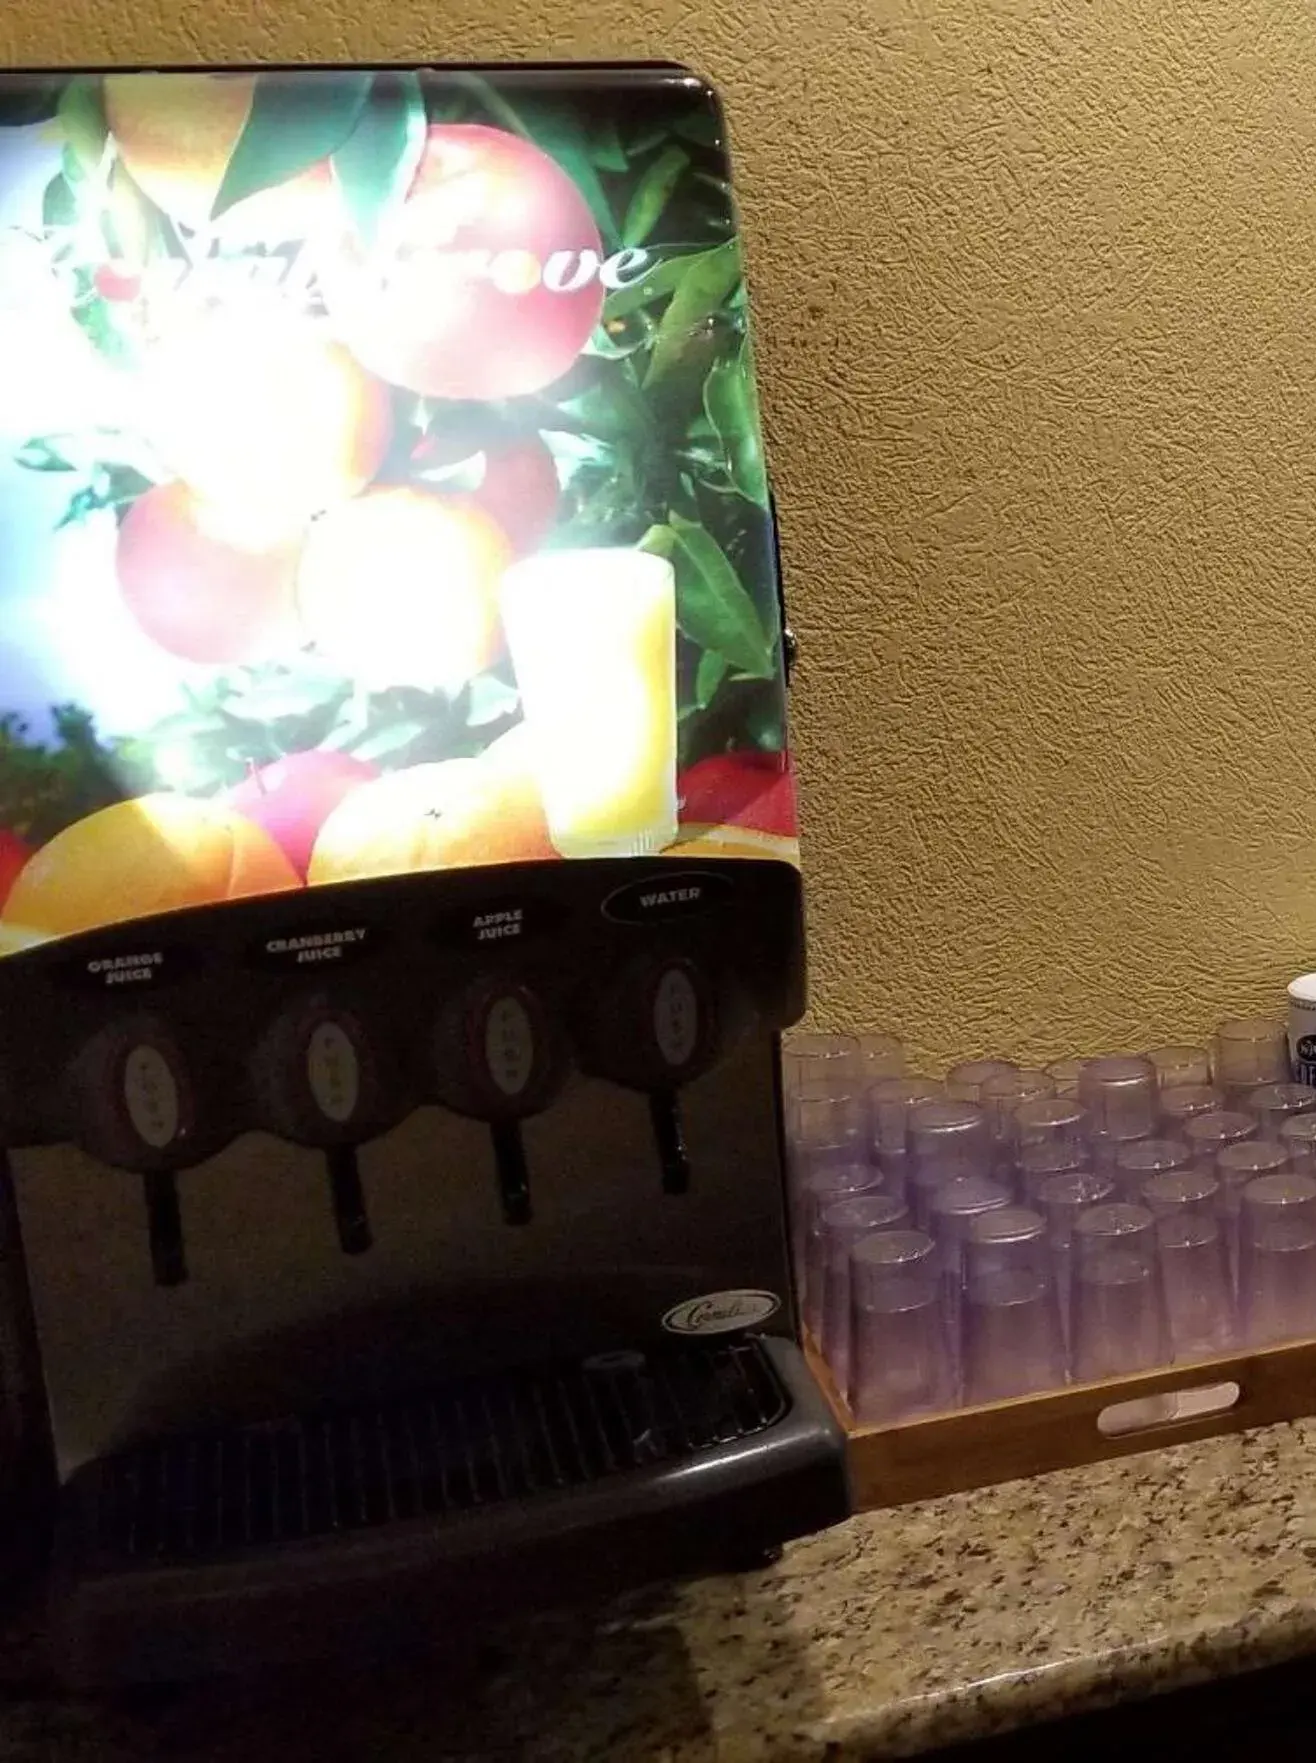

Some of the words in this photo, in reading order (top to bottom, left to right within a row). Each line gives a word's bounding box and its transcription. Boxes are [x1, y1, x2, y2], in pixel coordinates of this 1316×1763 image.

[639, 887, 702, 908] WATER
[472, 908, 524, 928] APPLE
[477, 923, 522, 941] JUICE
[296, 946, 343, 964] JUICE
